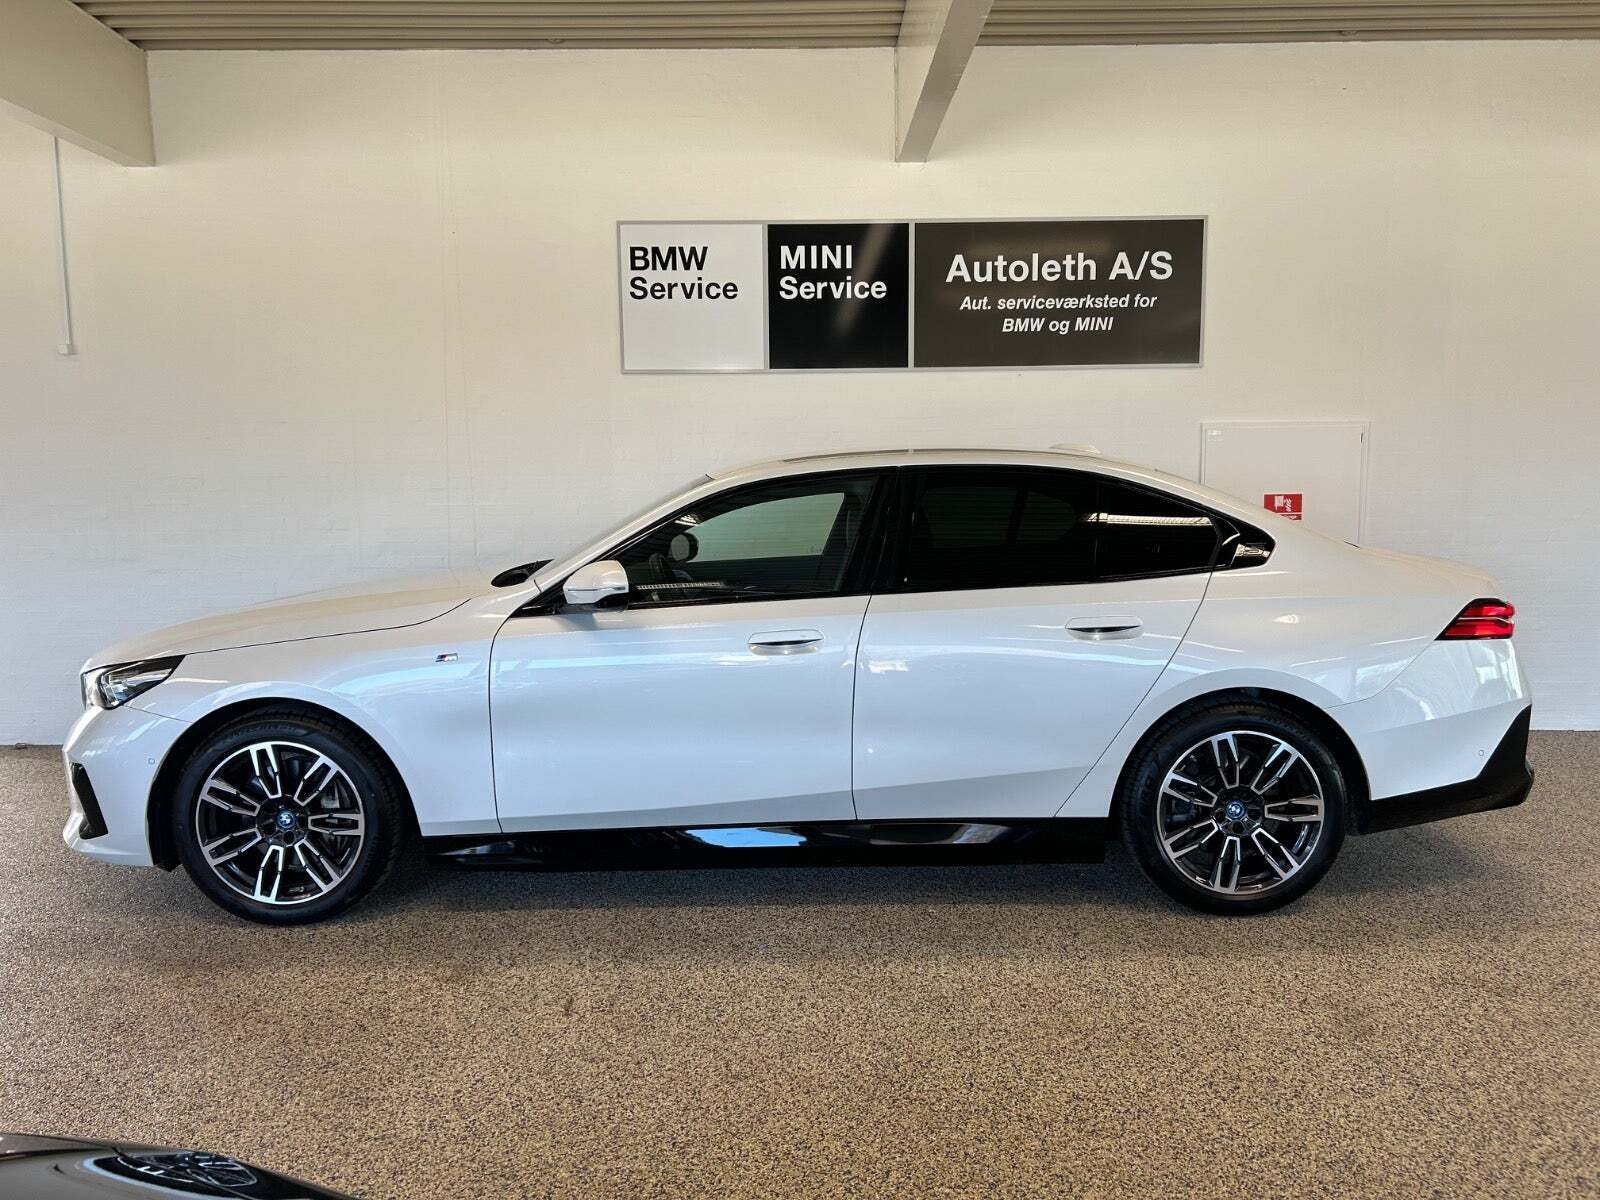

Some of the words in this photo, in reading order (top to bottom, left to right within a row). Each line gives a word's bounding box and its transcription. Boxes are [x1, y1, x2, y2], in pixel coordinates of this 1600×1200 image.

[630, 247, 708, 270] BMW
[780, 245, 851, 269] MINI
[946, 253, 1096, 282] Autoleth
[1109, 251, 1172, 280] A/S
[630, 277, 738, 299] Service
[780, 276, 886, 299] Service
[960, 295, 992, 310] Aut.
[997, 294, 1129, 310] serviceværksted
[1133, 293, 1158, 308] for
[1002, 317, 1045, 332] BMW
[1048, 320, 1071, 335] og
[1074, 316, 1114, 332] MINI
